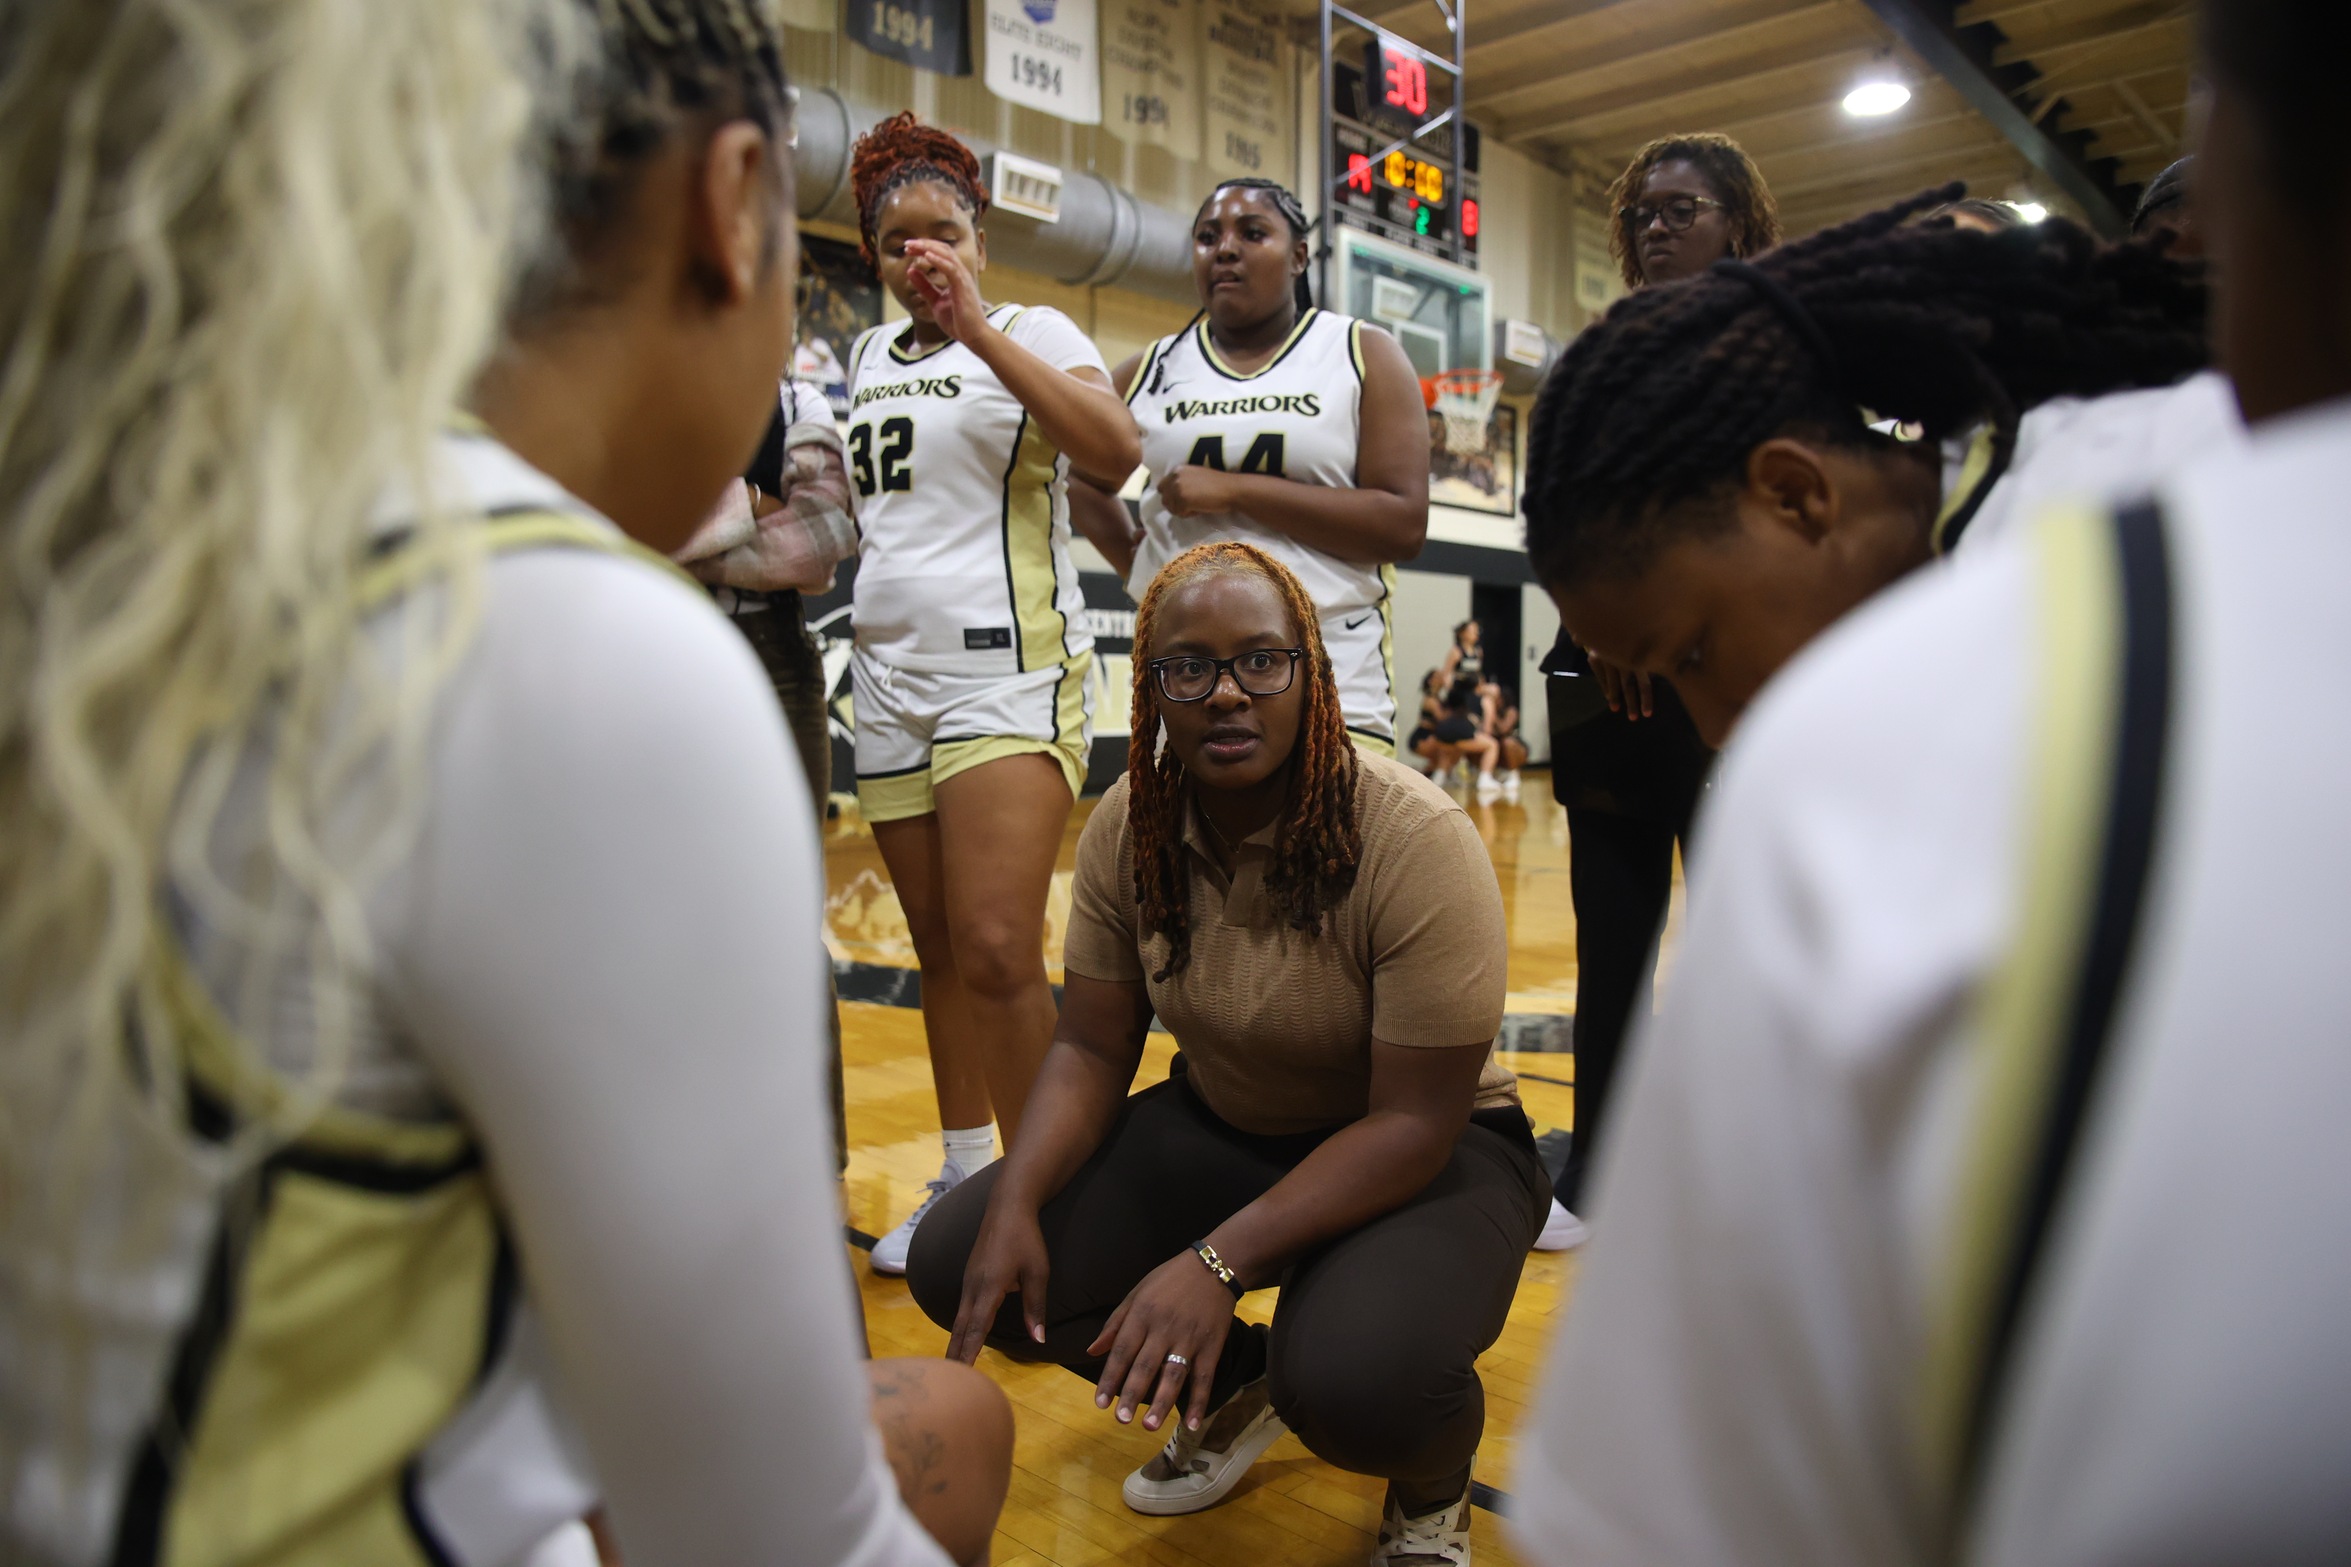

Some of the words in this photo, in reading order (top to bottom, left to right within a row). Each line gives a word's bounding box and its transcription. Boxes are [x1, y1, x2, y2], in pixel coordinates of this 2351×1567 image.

[872, 1, 935, 51] 1994
[990, 10, 1030, 44] ELITE
[1011, 53, 1062, 97] 1994
[1384, 48, 1427, 116] 30
[851, 374, 962, 412] WARRIORS
[1165, 393, 1321, 424] WARRIORS
[848, 416, 915, 498] 32
[1188, 433, 1288, 478] 44
